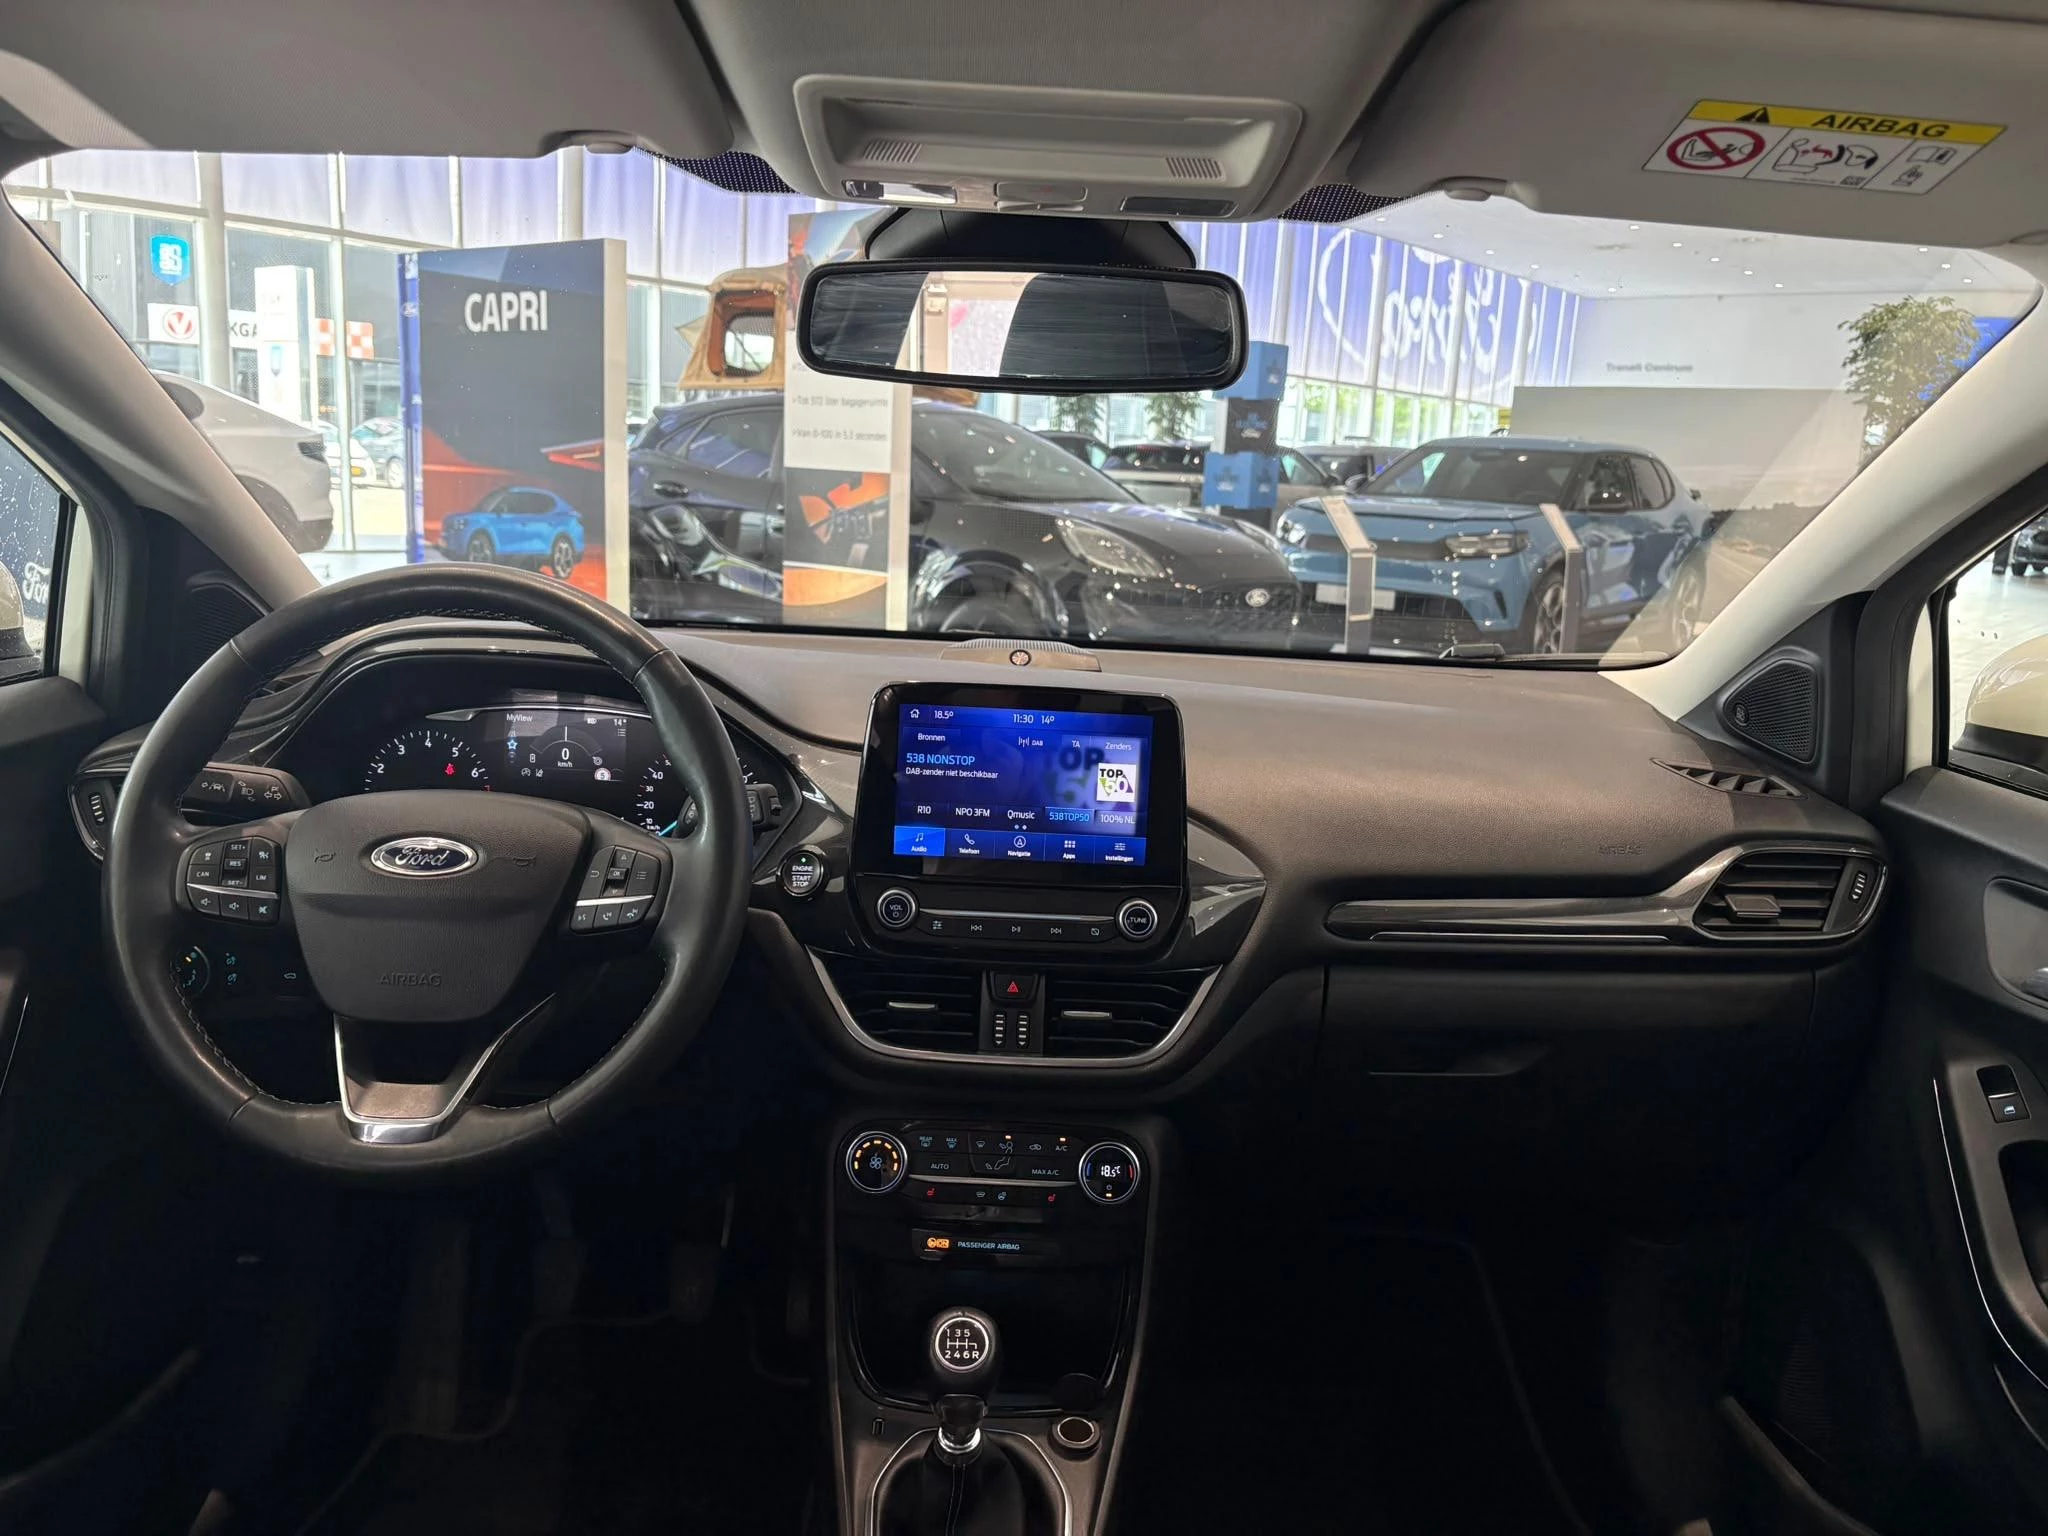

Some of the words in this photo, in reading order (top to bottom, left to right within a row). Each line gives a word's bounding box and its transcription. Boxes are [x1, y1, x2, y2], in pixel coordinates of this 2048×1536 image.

[1811, 114, 1950, 138] AIRBAG
[464, 290, 548, 333] CAPRI
[506, 713, 533, 722] MyView
[1013, 713, 1034, 724] 11:30
[917, 733, 946, 742] Bronnen
[424, 738, 432, 748] 4
[1071, 740, 1081, 748] TA
[1105, 742, 1132, 751] Zenders
[397, 744, 405, 755] 3
[452, 747, 459, 757] 5
[561, 748, 570, 760] 0
[906, 753, 925, 763] 538
[927, 754, 976, 766] NONSTOP
[377, 763, 384, 773] 2
[471, 767, 479, 778] 6
[905, 767, 945, 776] DAB-zender
[945, 769, 958, 777] niet
[959, 769, 999, 779] beschikbaar
[1100, 768, 1123, 778] TOP
[652, 771, 664, 780] 40
[643, 801, 655, 809] 20
[917, 805, 932, 814] R10
[955, 807, 973, 816] NPO
[973, 808, 990, 817] 3FM
[1007, 810, 1035, 819] Qmusic
[1100, 814, 1123, 824] 100%
[1124, 815, 1136, 824] NL
[911, 845, 928, 853] Audio
[958, 847, 980, 855] Telefoon
[394, 844, 450, 866] Ford
[1062, 852, 1076, 860] Apps
[1130, 916, 1147, 924] TUNE
[379, 972, 442, 987] AIRBAG
[957, 1241, 995, 1249] PASSENGER
[954, 1328, 961, 1338] 3
[963, 1328, 971, 1338] 5
[944, 1350, 951, 1359] 2
[953, 1350, 960, 1359] 4
[963, 1350, 970, 1359] 6
[972, 1350, 980, 1359] R
